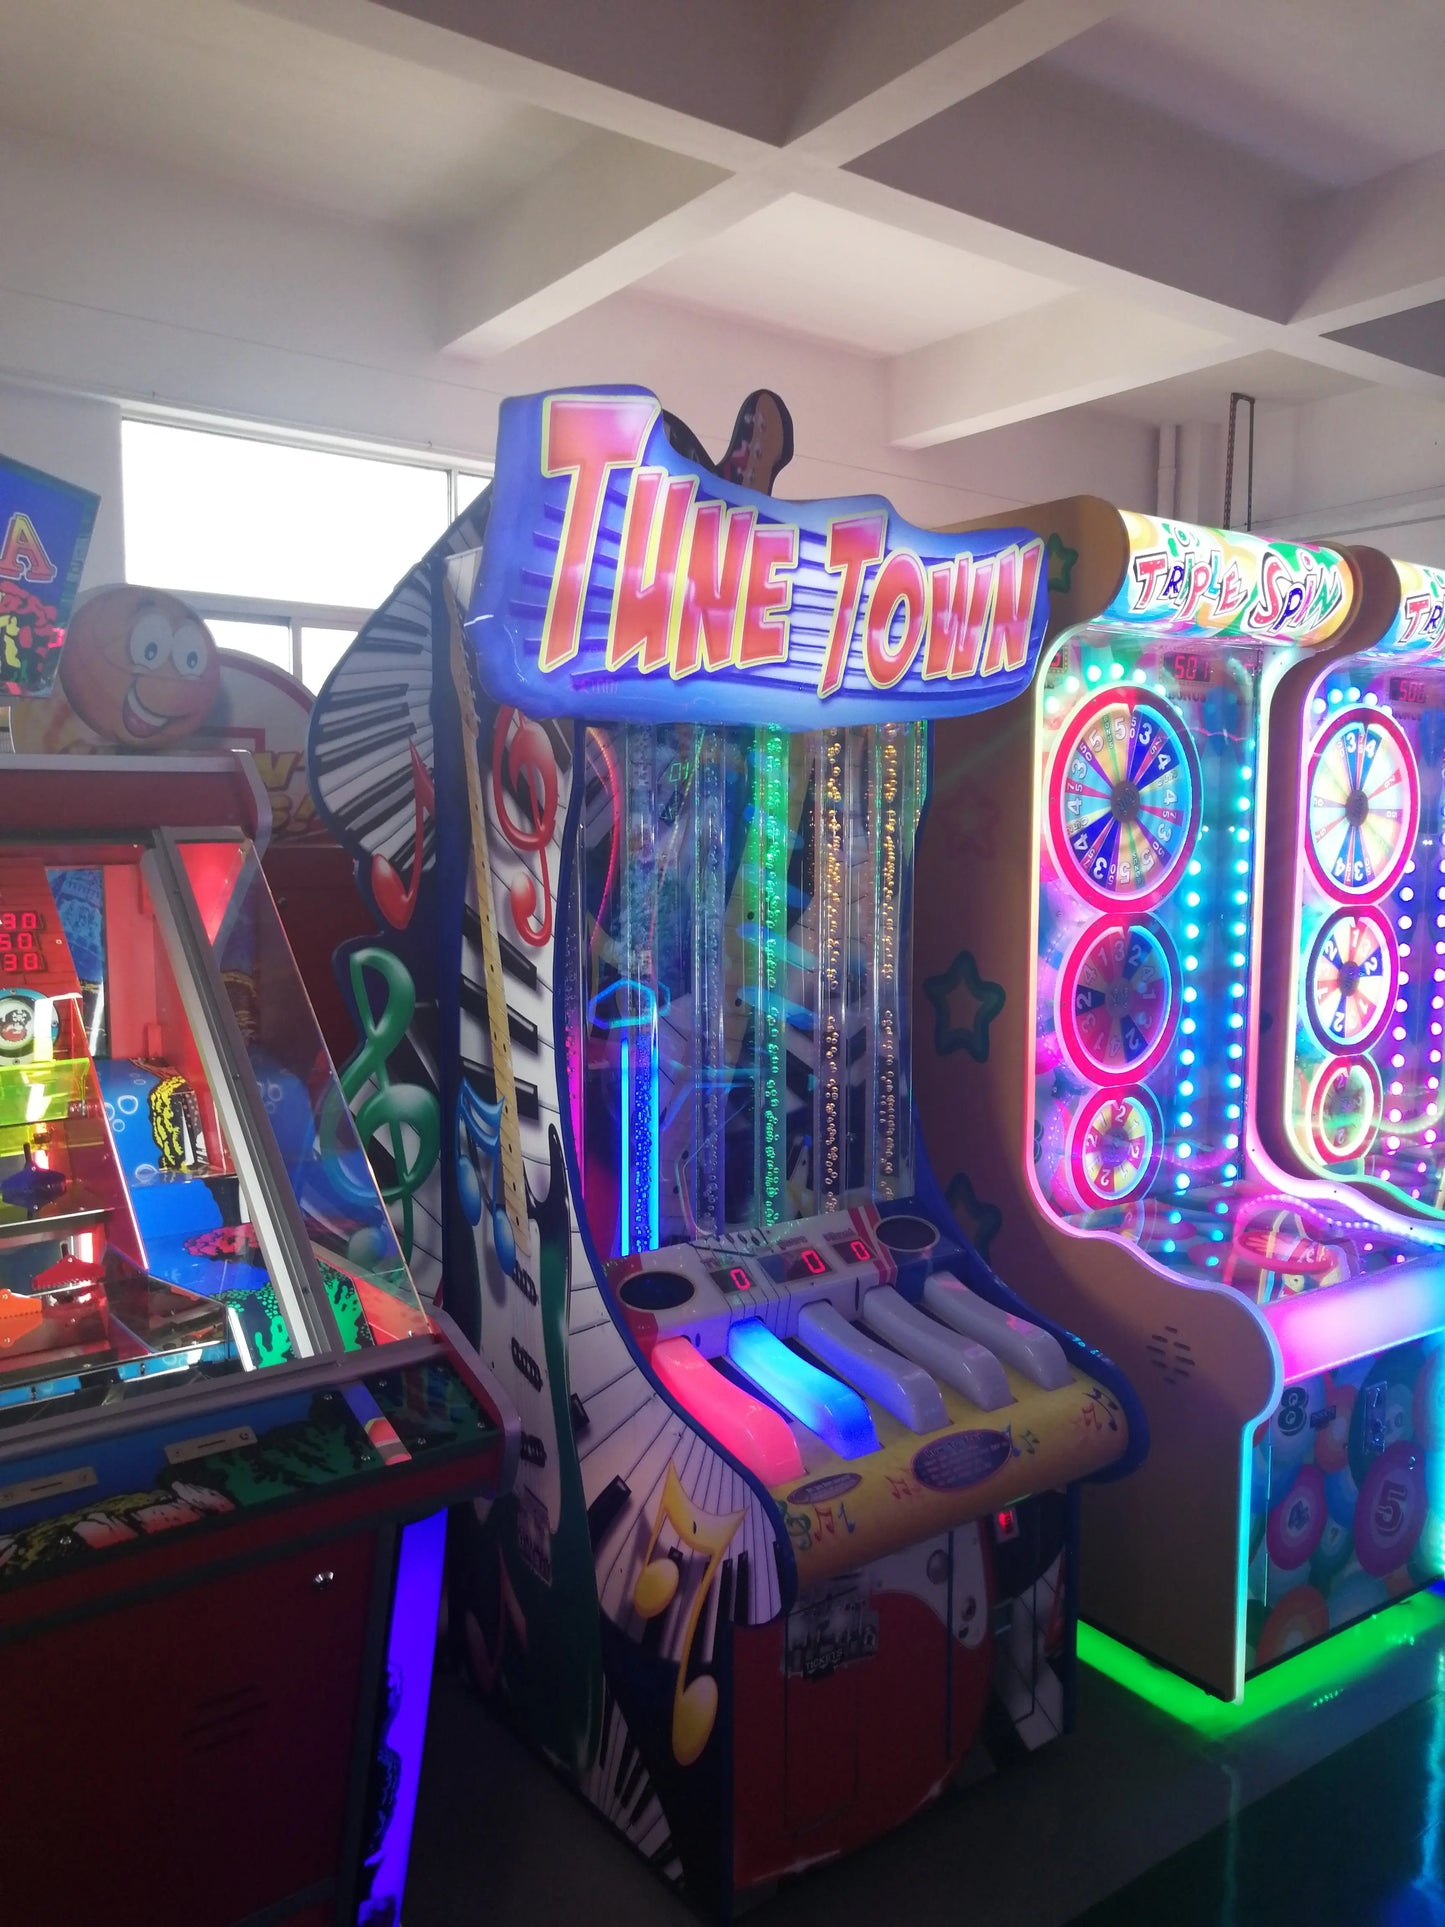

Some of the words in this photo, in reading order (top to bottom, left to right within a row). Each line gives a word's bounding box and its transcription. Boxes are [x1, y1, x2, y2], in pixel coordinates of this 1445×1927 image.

[540, 395, 799, 679] TUNE
[815, 509, 1044, 699] TOWN
[1114, 717, 1126, 740] 5
[1139, 723, 1152, 745] 3
[1089, 729, 1104, 752] 5
[1346, 733, 1356, 753] 3
[1365, 739, 1377, 758] 4
[1072, 759, 1087, 779] 3
[1158, 753, 1172, 770] 4
[1068, 798, 1082, 814] 4
[1163, 790, 1178, 805] 4
[1074, 833, 1088, 851] 4
[1158, 824, 1172, 842] 3
[1094, 857, 1108, 879] 3
[1141, 849, 1154, 870] 5
[1335, 858, 1346, 876] 4
[1120, 864, 1131, 883] 5
[1353, 862, 1364, 881] 3
[1353, 929, 1359, 947] 1
[1128, 945, 1142, 966] 2
[1325, 941, 1337, 961] 2
[1364, 957, 1378, 975] 2
[1077, 992, 1091, 1009] 2
[1333, 1012, 1344, 1032] 2
[1126, 1028, 1139, 1050] 2
[1115, 1105, 1126, 1123] 2
[1101, 1169, 1111, 1186] 2
[851, 1240, 870, 1261] 0
[801, 1250, 826, 1274] 0
[729, 1268, 750, 1290] 0
[1278, 1386, 1308, 1436] 8
[1374, 1480, 1408, 1536] 5
